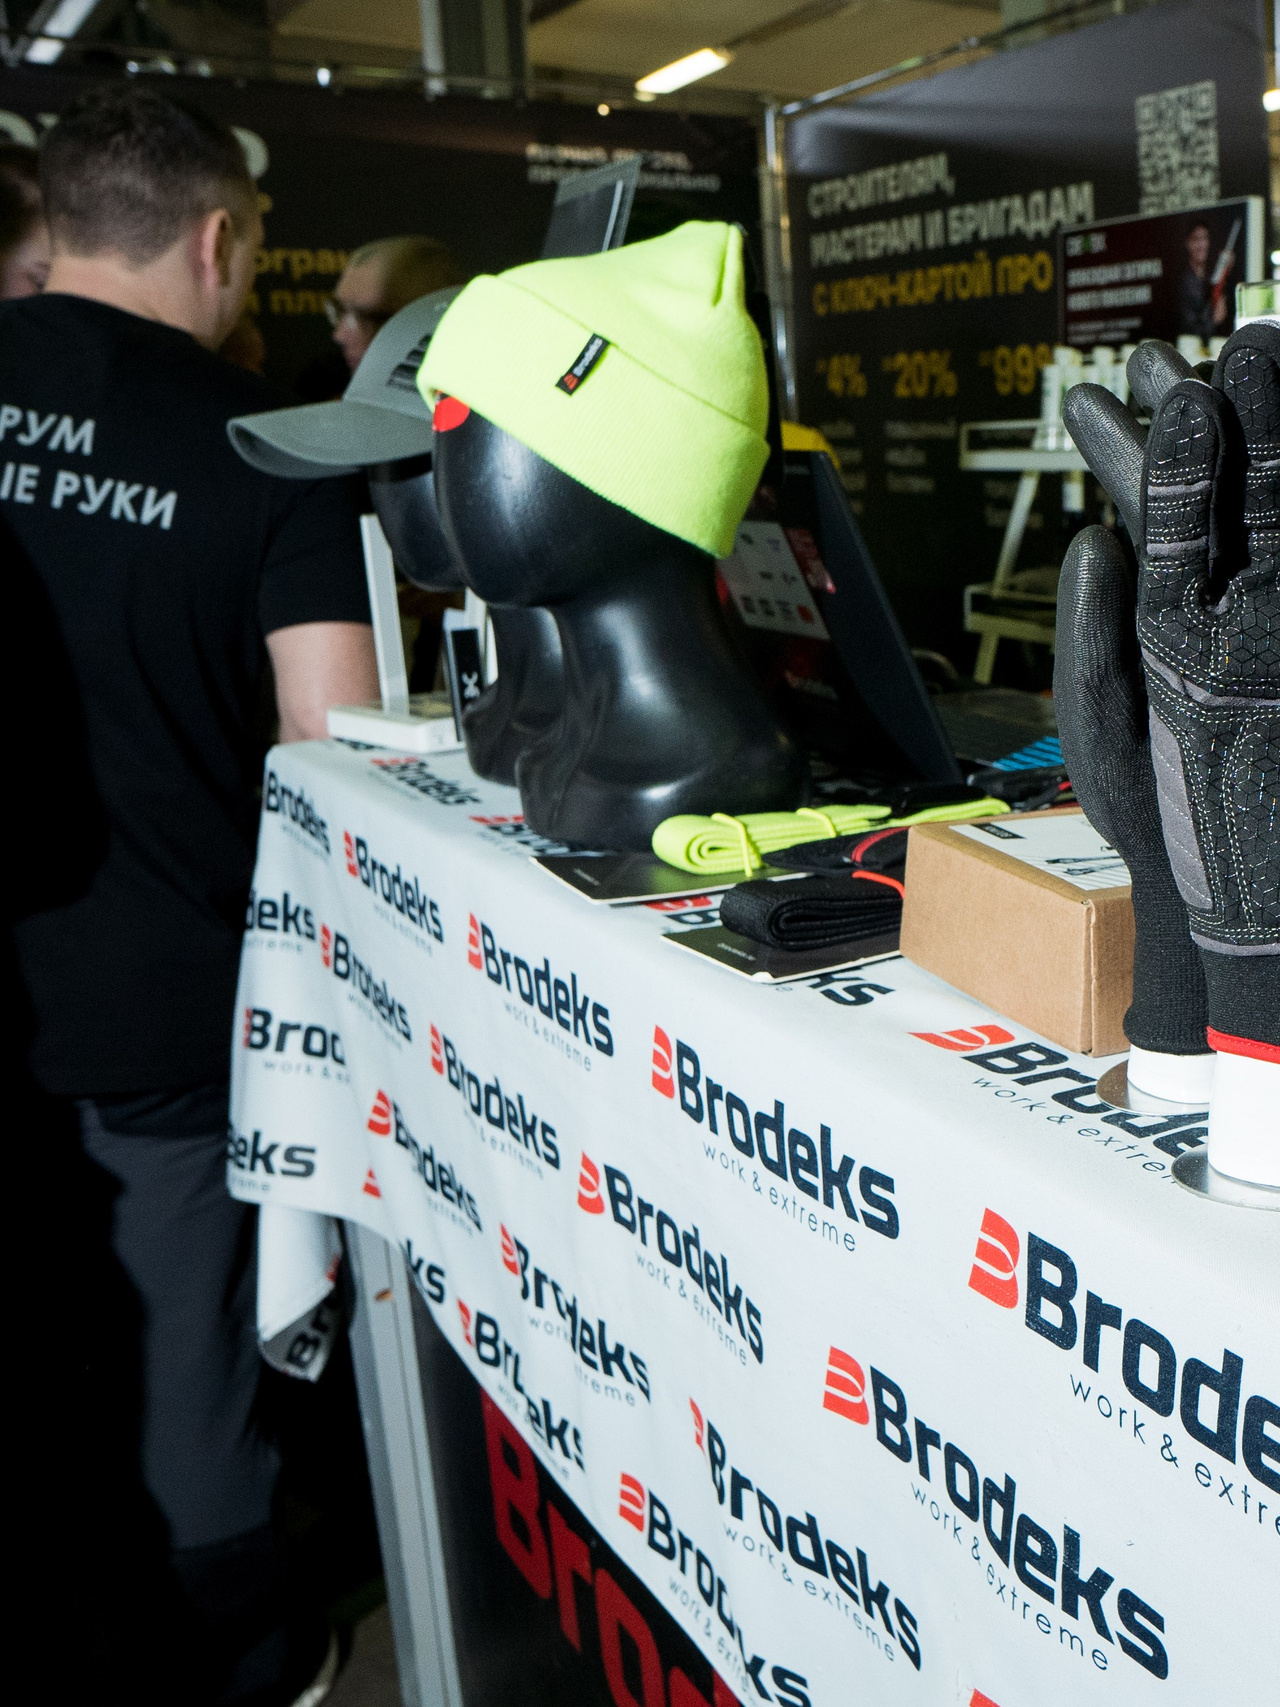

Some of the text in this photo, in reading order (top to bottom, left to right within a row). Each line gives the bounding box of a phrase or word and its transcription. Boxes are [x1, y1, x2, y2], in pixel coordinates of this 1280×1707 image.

[996, 250, 1053, 296] ПРО
[51, 469, 178, 530] РУКИ
[356, 836, 444, 943] Brodeks
[481, 922, 614, 1057] Brodeks
[443, 1034, 561, 1171] Brodeks
[675, 1038, 900, 1240] Brodeks
[972, 1077, 1047, 1112] work
[1046, 1113, 1074, 1125] &
[603, 1164, 764, 1365] Brodeks
[703, 1141, 856, 1253] work & extreme
[636, 1250, 671, 1290] work
[693, 1295, 748, 1366] extreme
[1070, 1373, 1147, 1445] work
[1160, 1434, 1179, 1469] &
[707, 1419, 922, 1672] Brodeks
[870, 1365, 1169, 1681] Brodeks
[911, 1481, 1109, 1673] work & extreme
[723, 1522, 777, 1570] work
[804, 1580, 895, 1663] extreme
